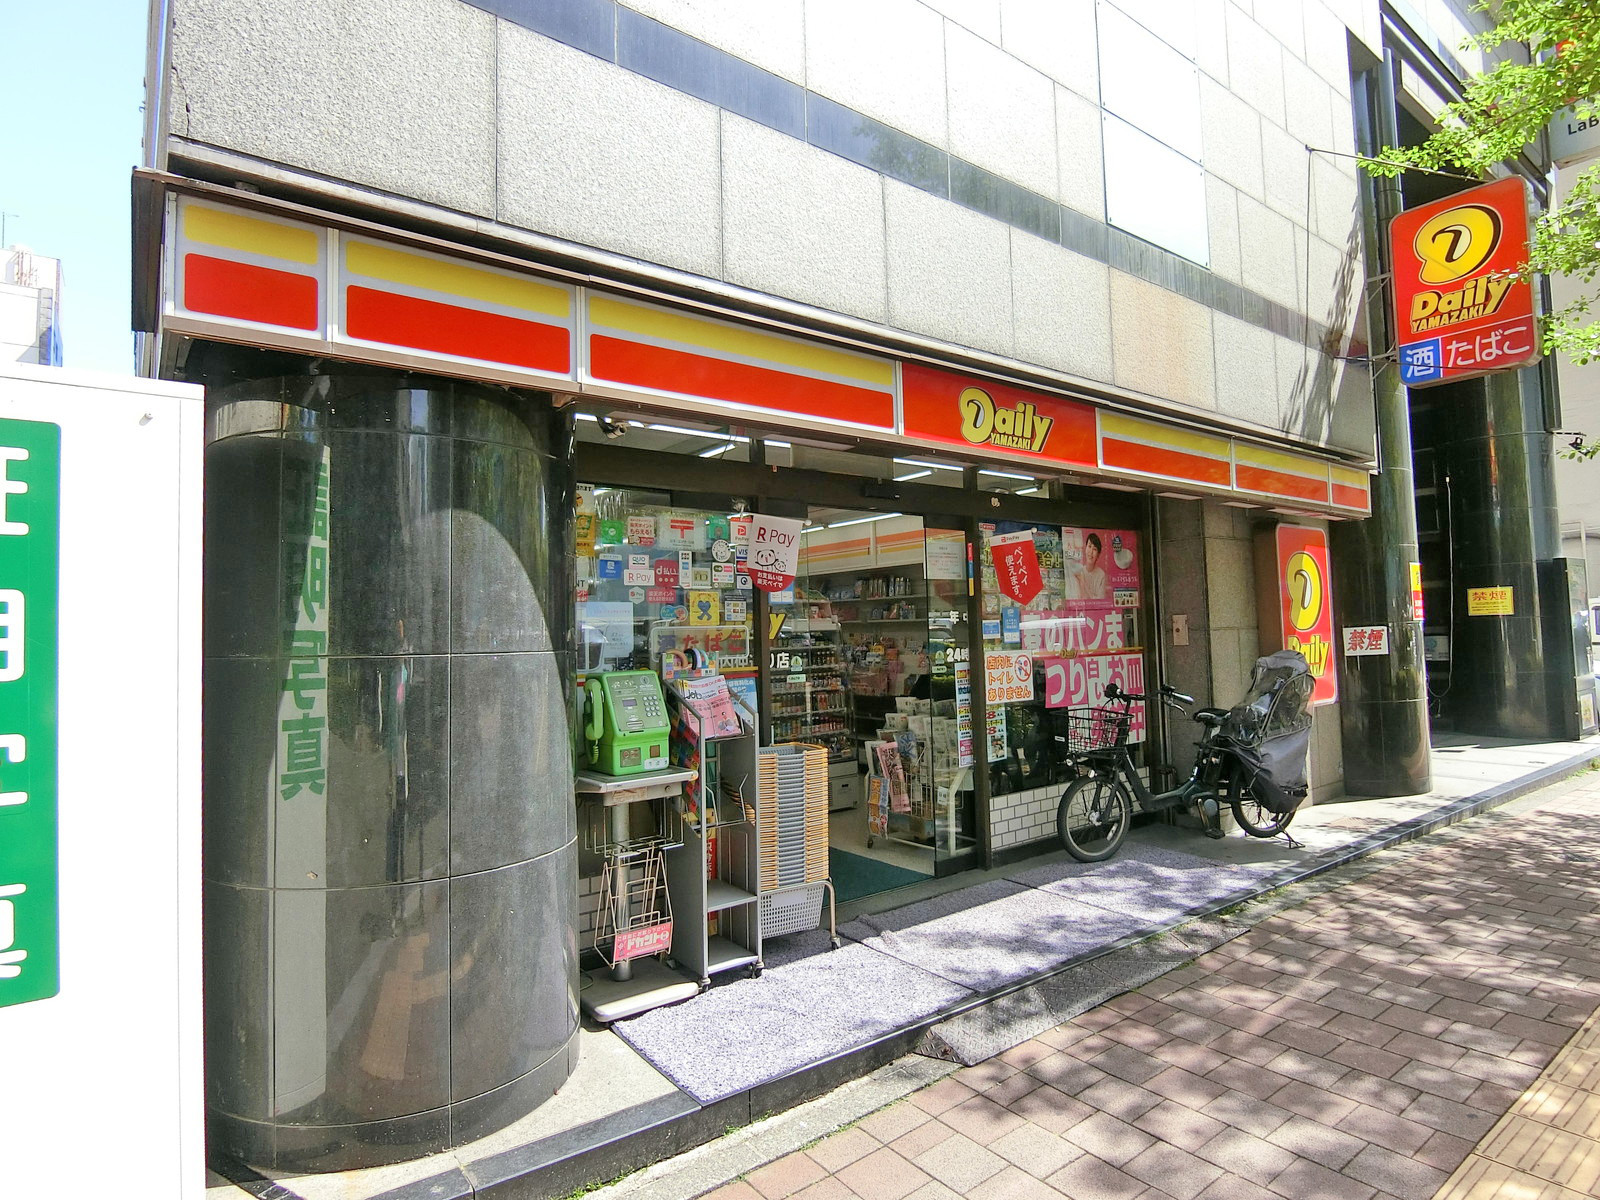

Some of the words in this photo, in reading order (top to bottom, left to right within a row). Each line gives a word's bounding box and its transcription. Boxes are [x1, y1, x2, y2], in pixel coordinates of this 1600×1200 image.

[1411, 274, 1514, 319] Daily
[1411, 306, 1485, 333] YAMAZAKI
[1446, 325, 1530, 368] たばこ
[1405, 345, 1435, 378] 酒
[959, 387, 1053, 452] Daily
[991, 432, 1031, 450] YAMAZAKI
[769, 529, 795, 548] Pay
[636, 573, 652, 583] Pay
[1014, 546, 1028, 586] ペイペイ
[1471, 590, 1508, 602] 禁煙
[1346, 628, 1385, 652] 禁煙
[986, 655, 1013, 670] 店内に
[988, 670, 1014, 686] トイレ
[1046, 660, 1085, 705] つり
[987, 685, 1032, 702] ありません
